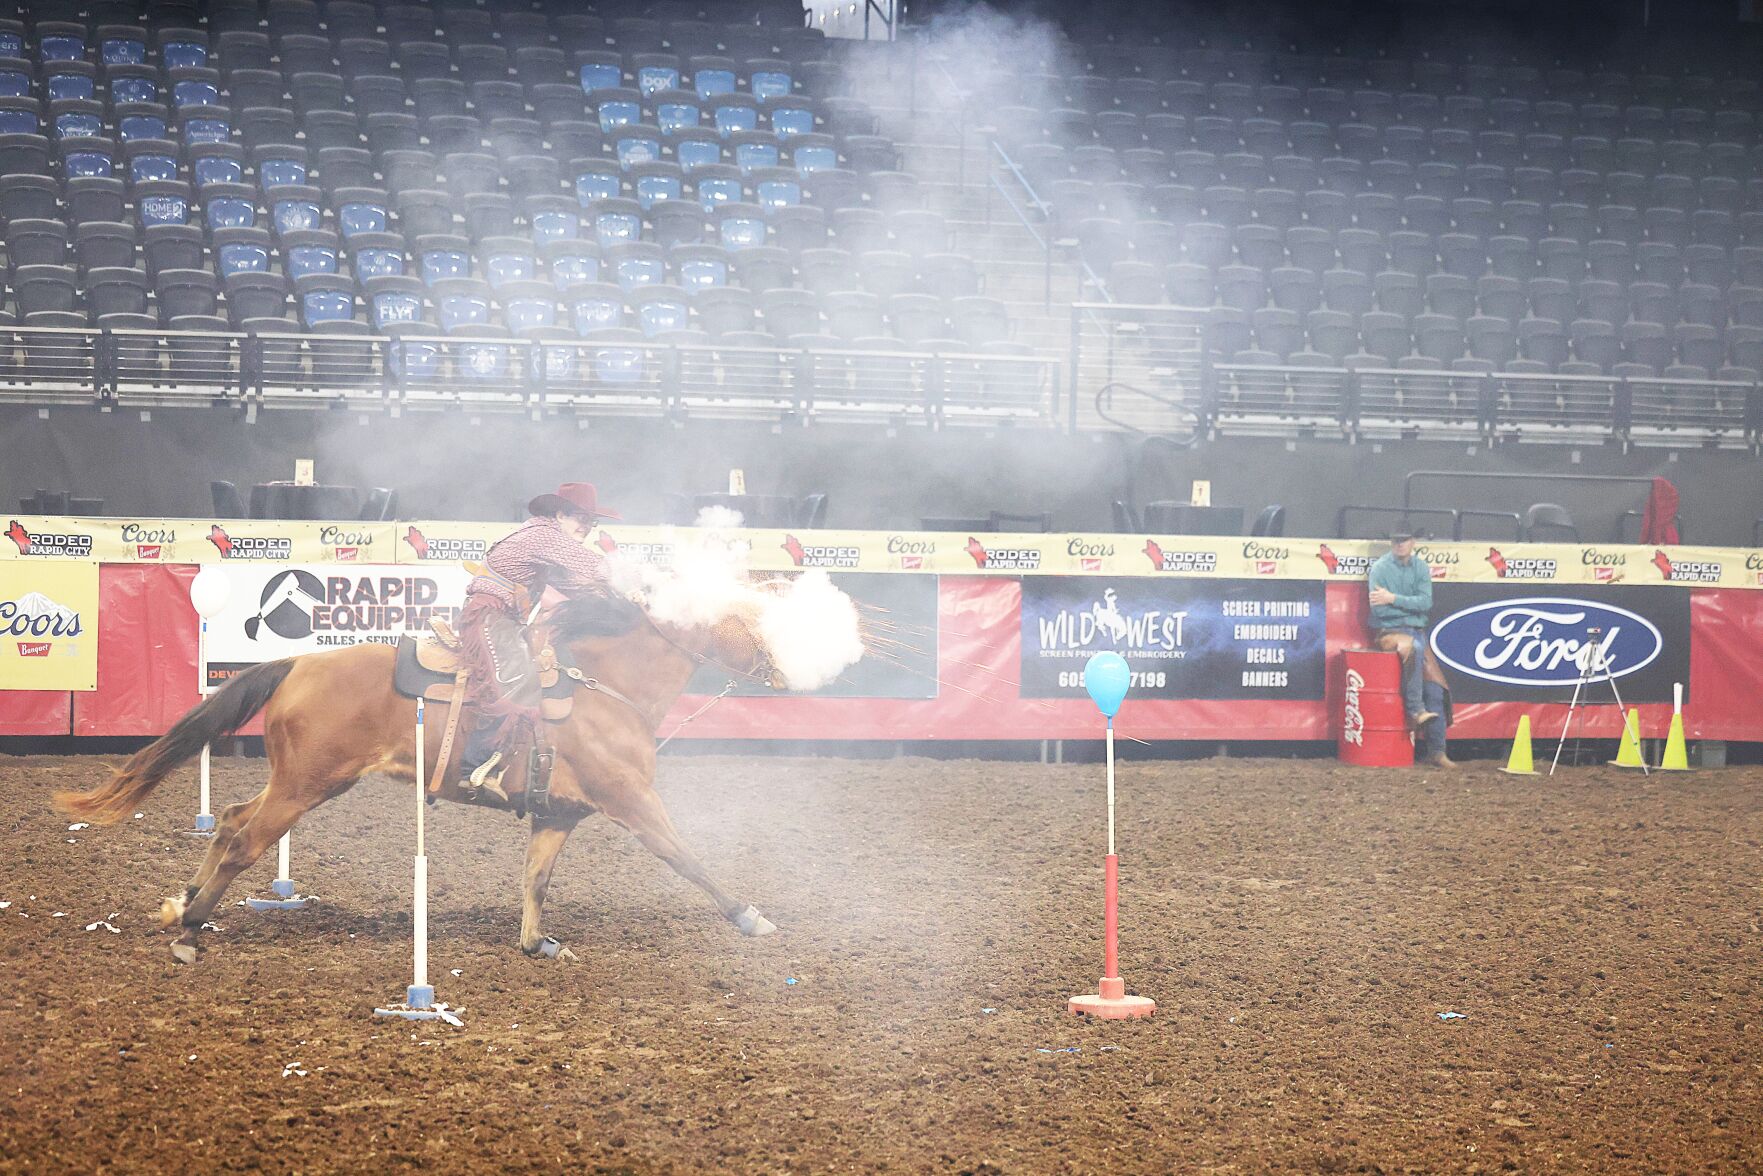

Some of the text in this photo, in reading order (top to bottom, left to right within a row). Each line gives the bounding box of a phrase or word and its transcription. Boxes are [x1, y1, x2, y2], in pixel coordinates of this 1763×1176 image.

[1, 42, 18, 50] ers
[121, 523, 175, 543] Coors
[320, 526, 372, 545] Coors
[30, 535, 91, 546] RODEO
[231, 539, 290, 548] RODEO
[427, 540, 485, 550] RODEO
[887, 535, 935, 554] Coors
[30, 546, 91, 556] RAPID CITY
[803, 547, 859, 557] RODEO
[1067, 538, 1115, 556] Coors
[1242, 541, 1289, 559] Coors
[231, 549, 290, 559] RAPID CITY
[427, 550, 484, 560] RAPID CITY
[986, 550, 1040, 559] RODEO
[1163, 552, 1216, 562] RODEO
[1581, 547, 1626, 565] Coors
[803, 557, 858, 567] RAPID CITY
[985, 559, 1039, 569] RAPID CITY
[1162, 562, 1216, 571] RAPID CITY
[1337, 556, 1376, 567] RODE
[1506, 559, 1556, 569] RODEO
[1336, 566, 1365, 574] RAPID
[1671, 562, 1720, 572] RODEO
[1505, 569, 1555, 578] RAPID CITY
[1671, 572, 1720, 582] RAPID CITY
[327, 577, 438, 605] RAPID
[1222, 600, 1310, 617] SCREEN PRINTING
[0, 601, 83, 636] Coors
[313, 606, 462, 632] EQUIPME
[1040, 610, 1188, 651] WILD WEST
[1234, 624, 1299, 640] EMBROIDERY
[316, 635, 356, 645] SALES
[1475, 608, 1620, 672] Ford
[21, 644, 48, 655] Banquet
[1039, 650, 1074, 658] SCREEN
[1127, 651, 1187, 659] EMBROIDERY
[1246, 648, 1285, 663] DECALS
[1241, 671, 1288, 687] BANNERS
